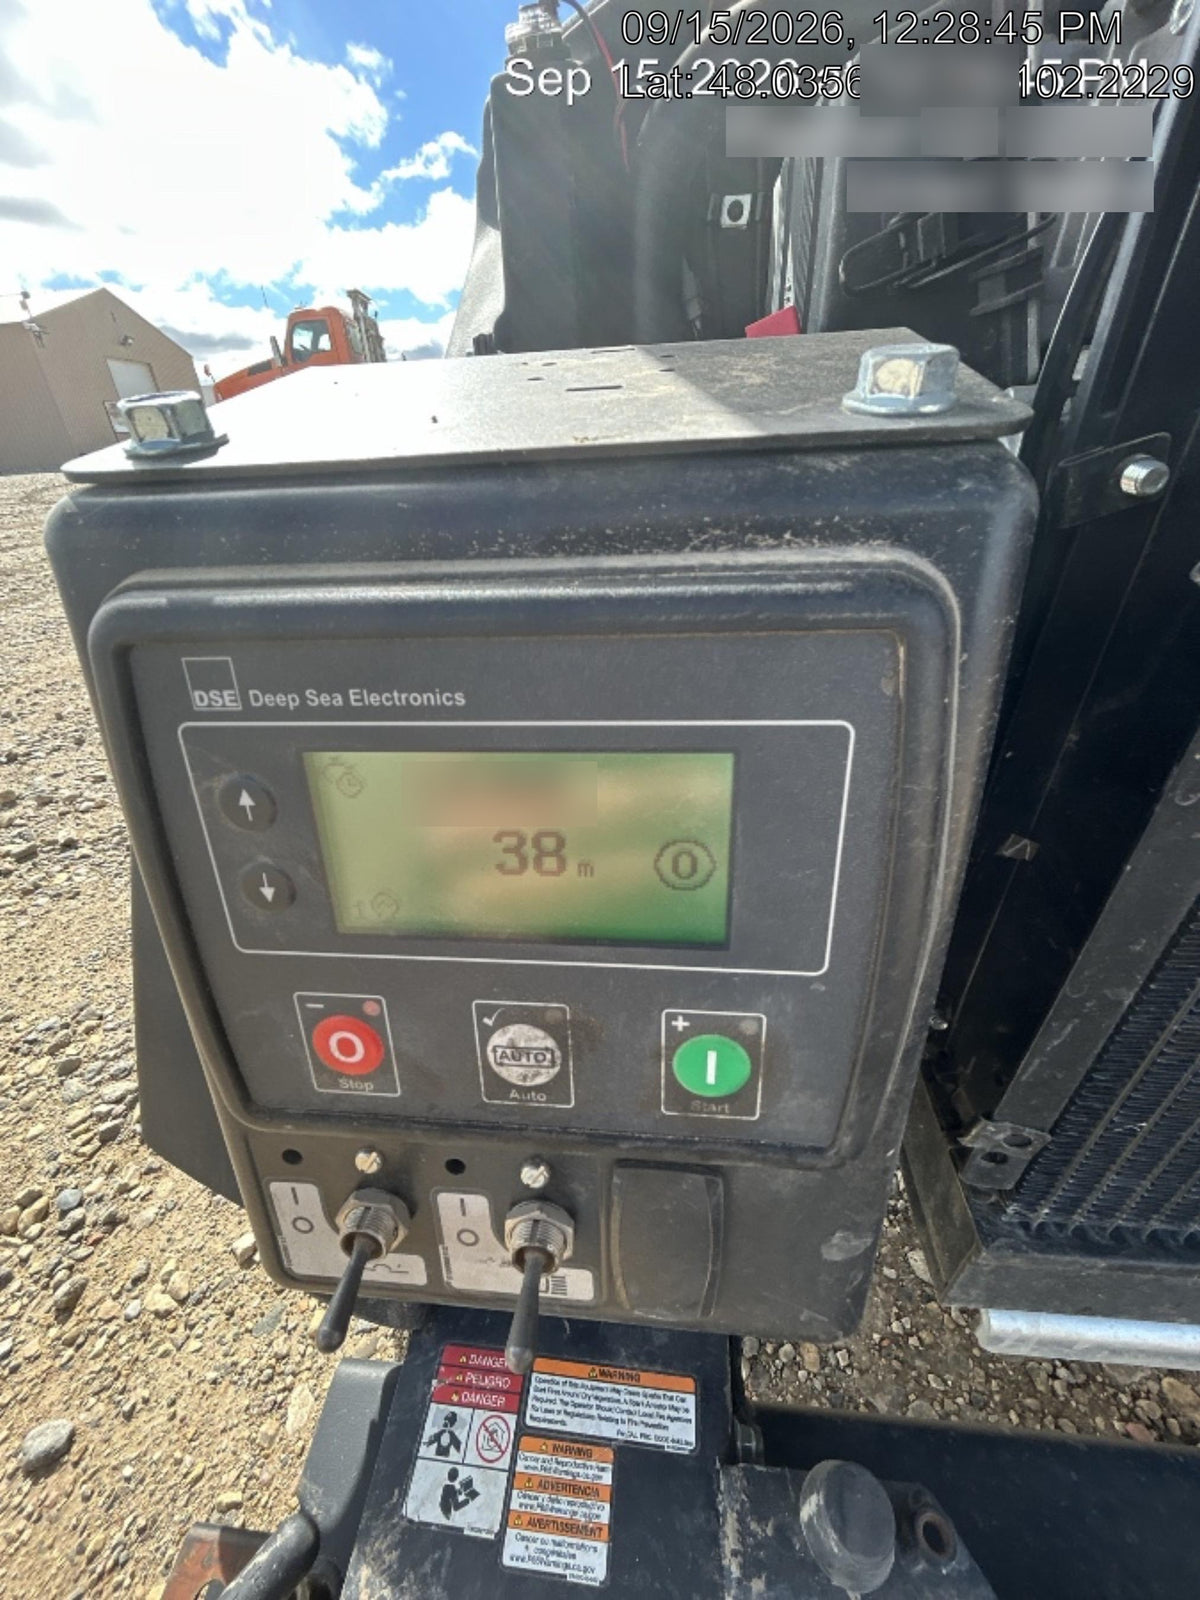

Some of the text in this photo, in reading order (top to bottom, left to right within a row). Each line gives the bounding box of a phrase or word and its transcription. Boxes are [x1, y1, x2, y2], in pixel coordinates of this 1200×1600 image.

[193, 690, 240, 706] DSE
[249, 688, 466, 710] Deep Sea Electronics
[493, 831, 567, 877] 38
[500, 1050, 547, 1065] AUTO
[339, 1078, 374, 1092] Stop
[510, 1088, 547, 1102] Auto
[691, 1100, 731, 1115] Start
[465, 1371, 511, 1389] PELIGRO
[599, 1367, 640, 1384] WARNING
[461, 1391, 506, 1408] DANGER
[552, 1442, 593, 1459] WARNING
[537, 1479, 600, 1498] ADVERTENCIA
[527, 1516, 604, 1538] AVERTISSEMENT
